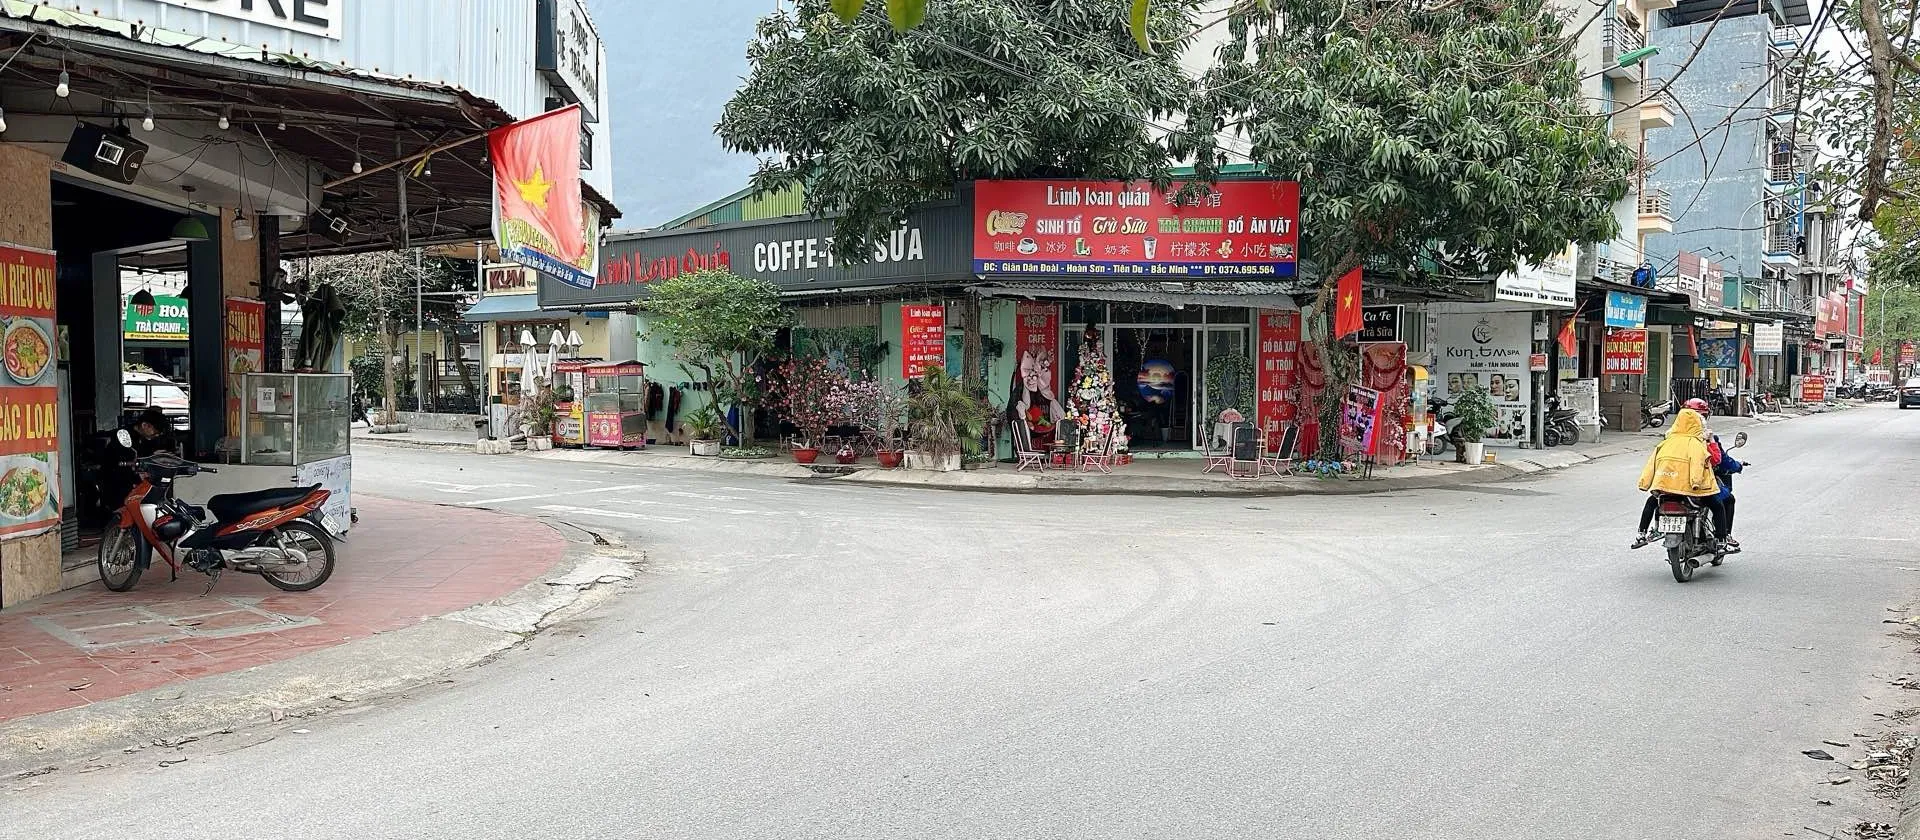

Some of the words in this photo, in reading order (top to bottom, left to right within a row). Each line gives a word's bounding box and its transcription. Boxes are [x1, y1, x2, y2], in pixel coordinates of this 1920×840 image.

[1048, 185, 1081, 207] Linh
[1085, 186, 1113, 206] loan
[1118, 187, 1150, 208] quán
[1037, 218, 1064, 234] SINH
[1066, 214, 1083, 234] TỐ
[1093, 217, 1118, 234] Trà
[1121, 216, 1149, 235] Sữa
[1158, 215, 1180, 233] TRÀ
[1183, 217, 1223, 233] CHANH
[1250, 216, 1267, 233] ĂN
[1270, 216, 1291, 236] VẶT
[994, 241, 1015, 253] 咖啡
[1046, 241, 1067, 253] 冰沙
[1104, 244, 1131, 255] 奶茶
[1170, 241, 1211, 257] 柠檬茶
[1241, 242, 1267, 257] 小吃
[1066, 264, 1087, 273] Hoàn
[1090, 264, 1105, 273] Sơn
[1132, 265, 1143, 274] Du
[1151, 263, 1167, 274] Bắc
[1169, 265, 1188, 274] Ninh
[1204, 265, 1217, 274] ĐT:
[1219, 265, 1275, 274] 0374.695.564
[1363, 311, 1377, 321] Ca
[153, 321, 181, 333] CHANH
[249, 308, 261, 344] CÁ
[1376, 326, 1393, 337] Sữa
[1028, 334, 1046, 343] CAFE
[1606, 339, 1618, 353] BÚN
[1276, 357, 1294, 374] TRỘN
[1606, 355, 1619, 370] BÚN
[1621, 355, 1629, 370] BÒ
[1630, 354, 1643, 370] HUẾ
[1273, 388, 1283, 401] ĂN
